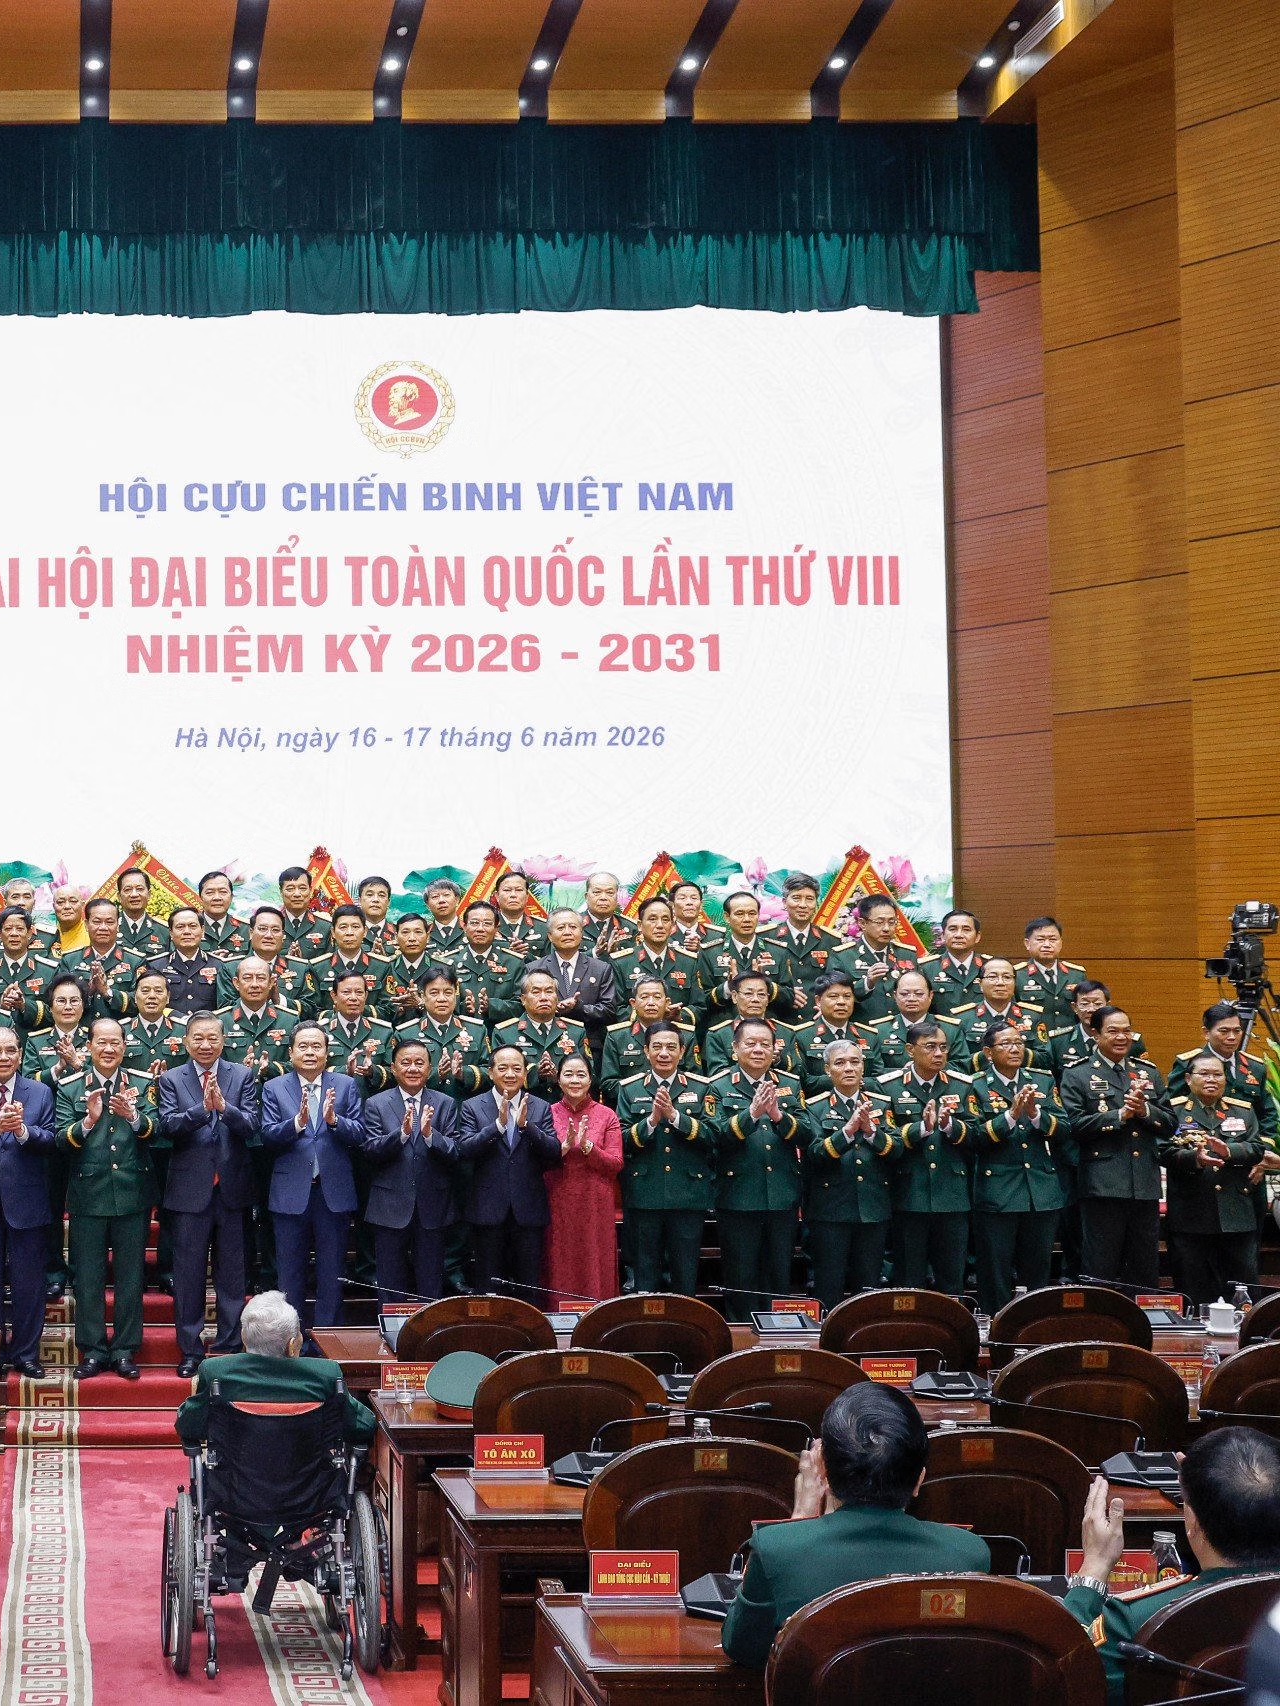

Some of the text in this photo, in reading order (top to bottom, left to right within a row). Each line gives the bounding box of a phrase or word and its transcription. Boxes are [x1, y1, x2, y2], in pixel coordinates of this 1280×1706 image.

[100, 474, 732, 518] HỘI CỰU CHIẾN BINH VIỆT NAM
[40, 548, 112, 618] HỘI
[130, 558, 206, 618] ĐẠI
[225, 537, 327, 606] BIỂU
[345, 547, 464, 606] TOÀN
[484, 538, 604, 612] QUỐC
[623, 538, 709, 605] LẦN
[726, 545, 816, 606] THỨ
[828, 556, 899, 605] VIII
[128, 628, 302, 681] NHIỆM
[327, 627, 390, 672] KỲ
[412, 635, 540, 672] 2026
[600, 634, 719, 671] 2031
[176, 728, 207, 747] Hà
[218, 728, 265, 752] Nội,
[278, 729, 338, 752] ngày
[350, 728, 375, 747] 16
[404, 728, 431, 747] 17
[441, 727, 511, 752] tháng
[522, 727, 533, 746] 6
[545, 727, 596, 746] năm
[608, 727, 664, 746] 2026
[568, 1359, 583, 1372] 02
[483, 1448, 536, 1459] TÔ ÂN XÔ
[701, 1452, 720, 1469] 02
[617, 1559, 652, 1570] ĐẠI BIỂU
[930, 1592, 956, 1616] 02
